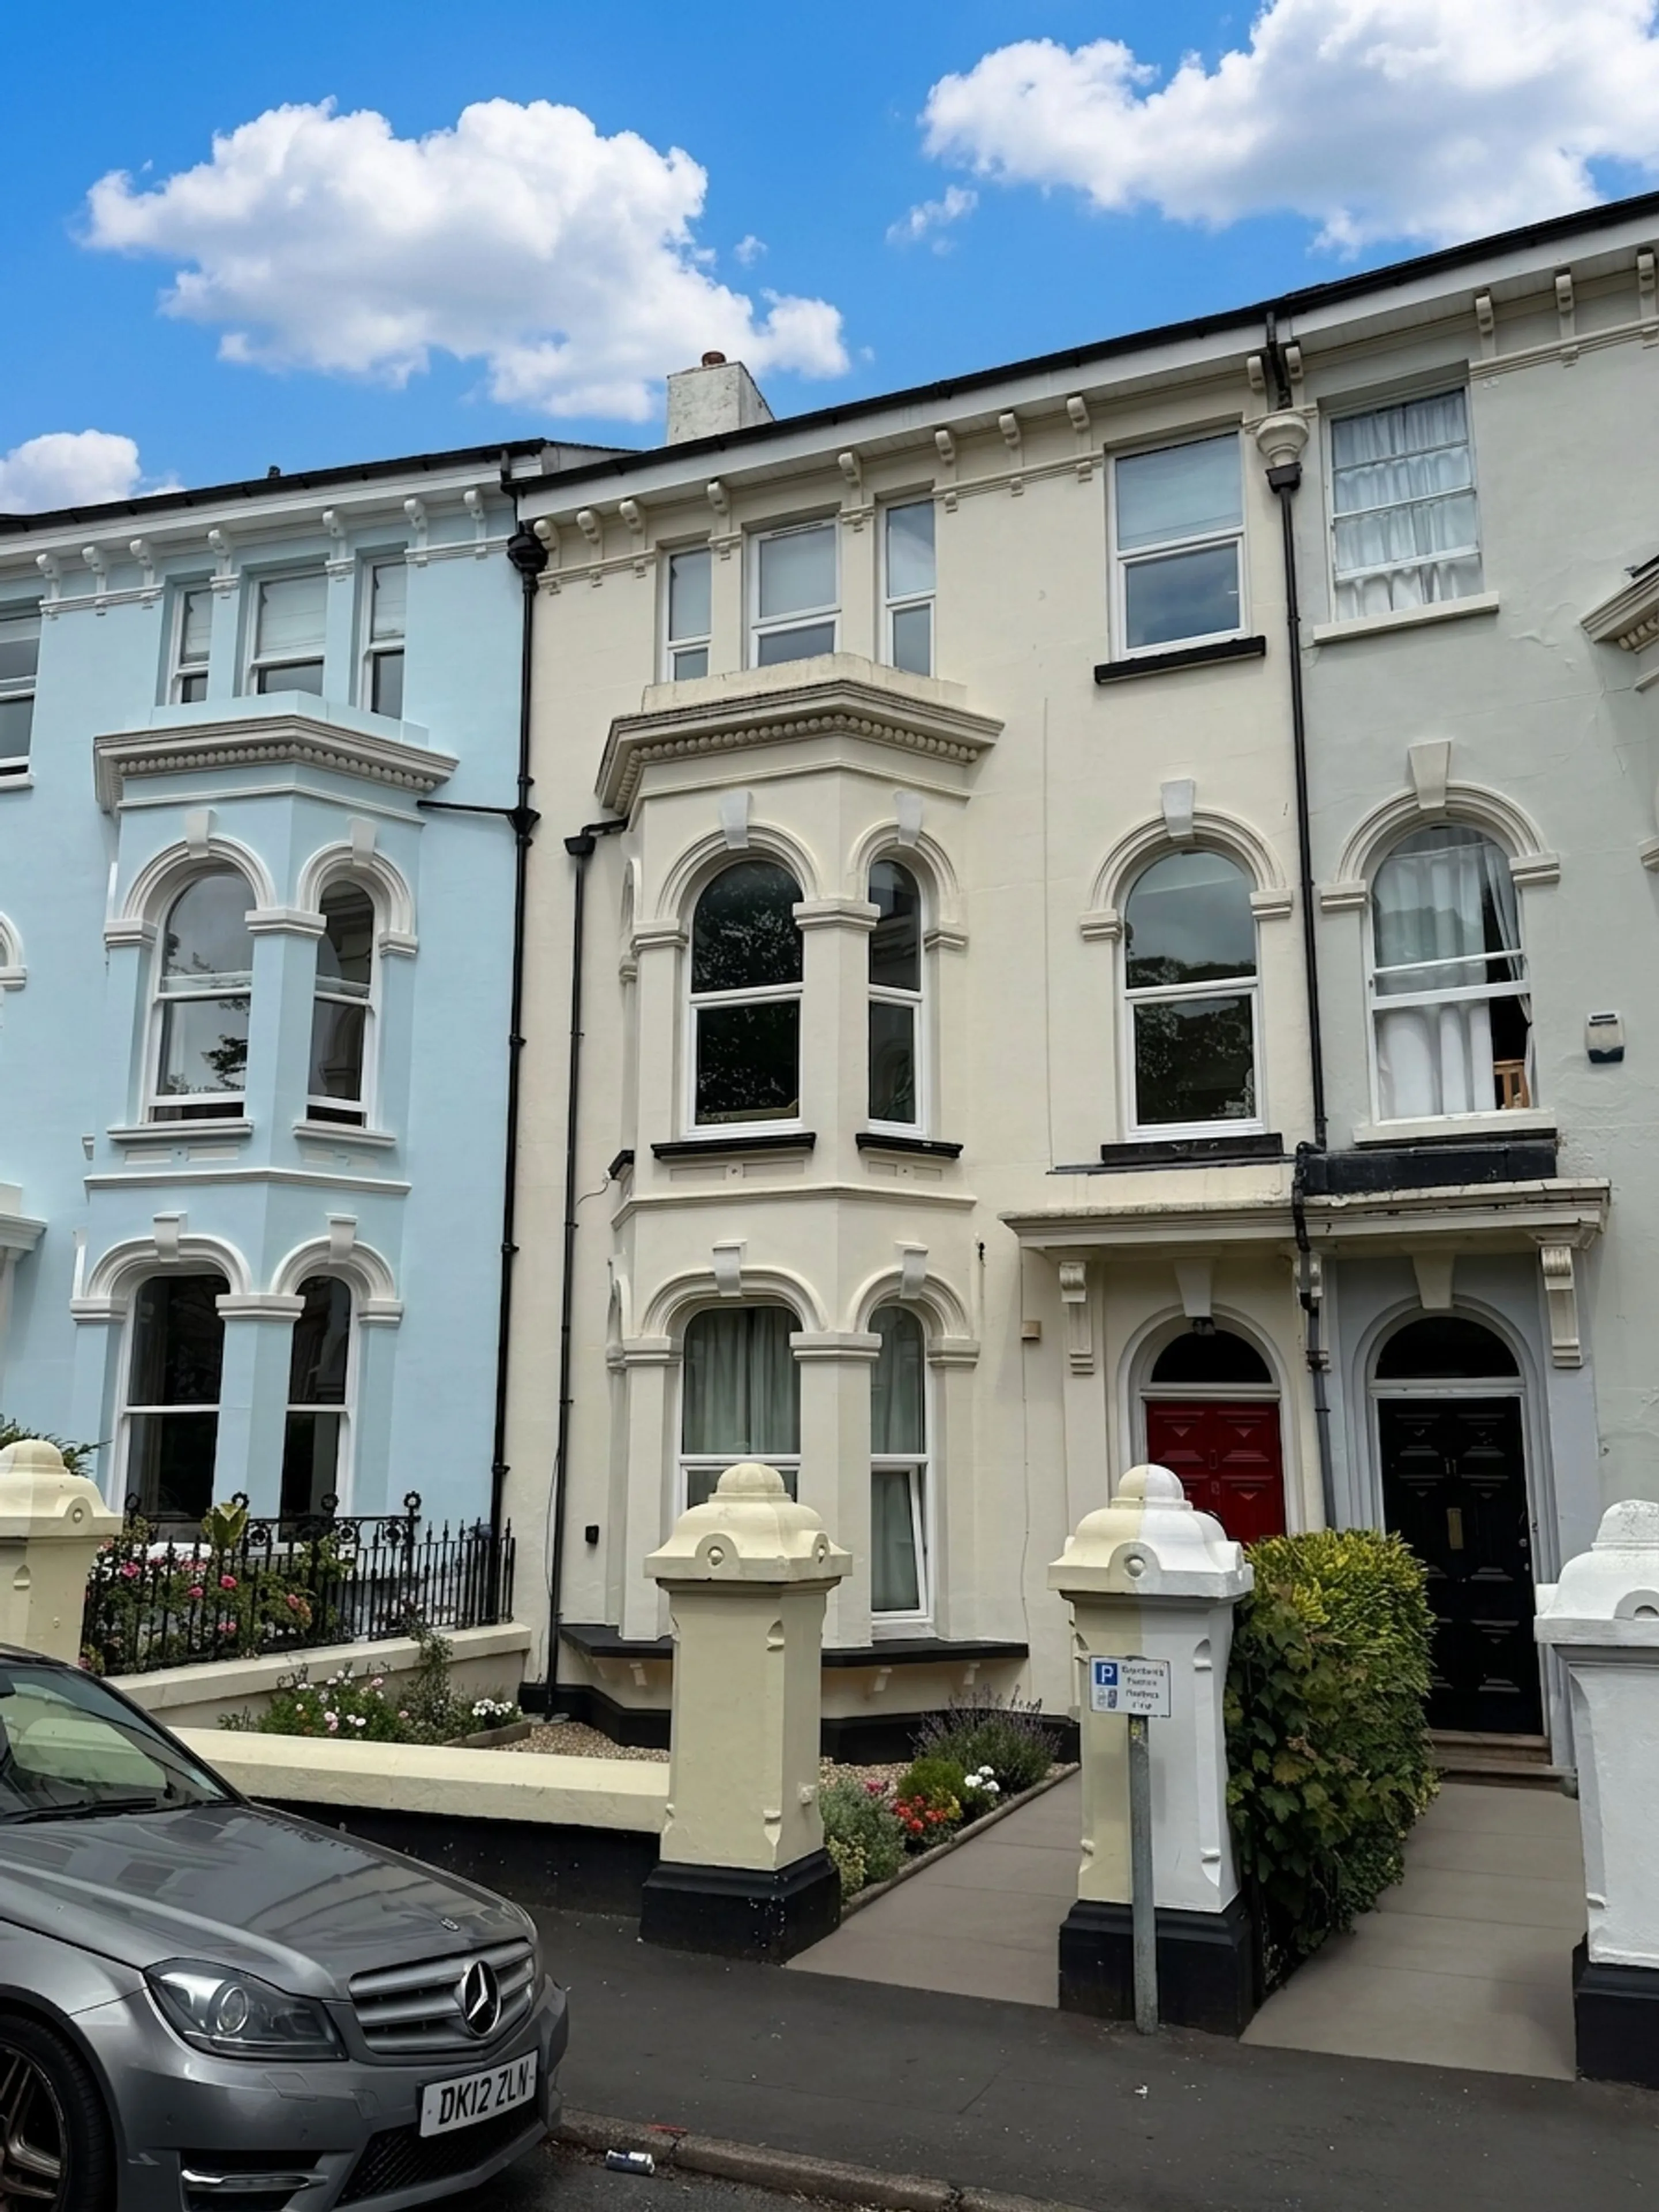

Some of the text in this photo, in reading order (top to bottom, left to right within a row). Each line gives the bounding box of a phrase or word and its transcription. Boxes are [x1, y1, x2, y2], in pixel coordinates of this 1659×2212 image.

[1101, 1665, 1113, 1683] P
[438, 2061, 529, 2125] DK12 ZLN
